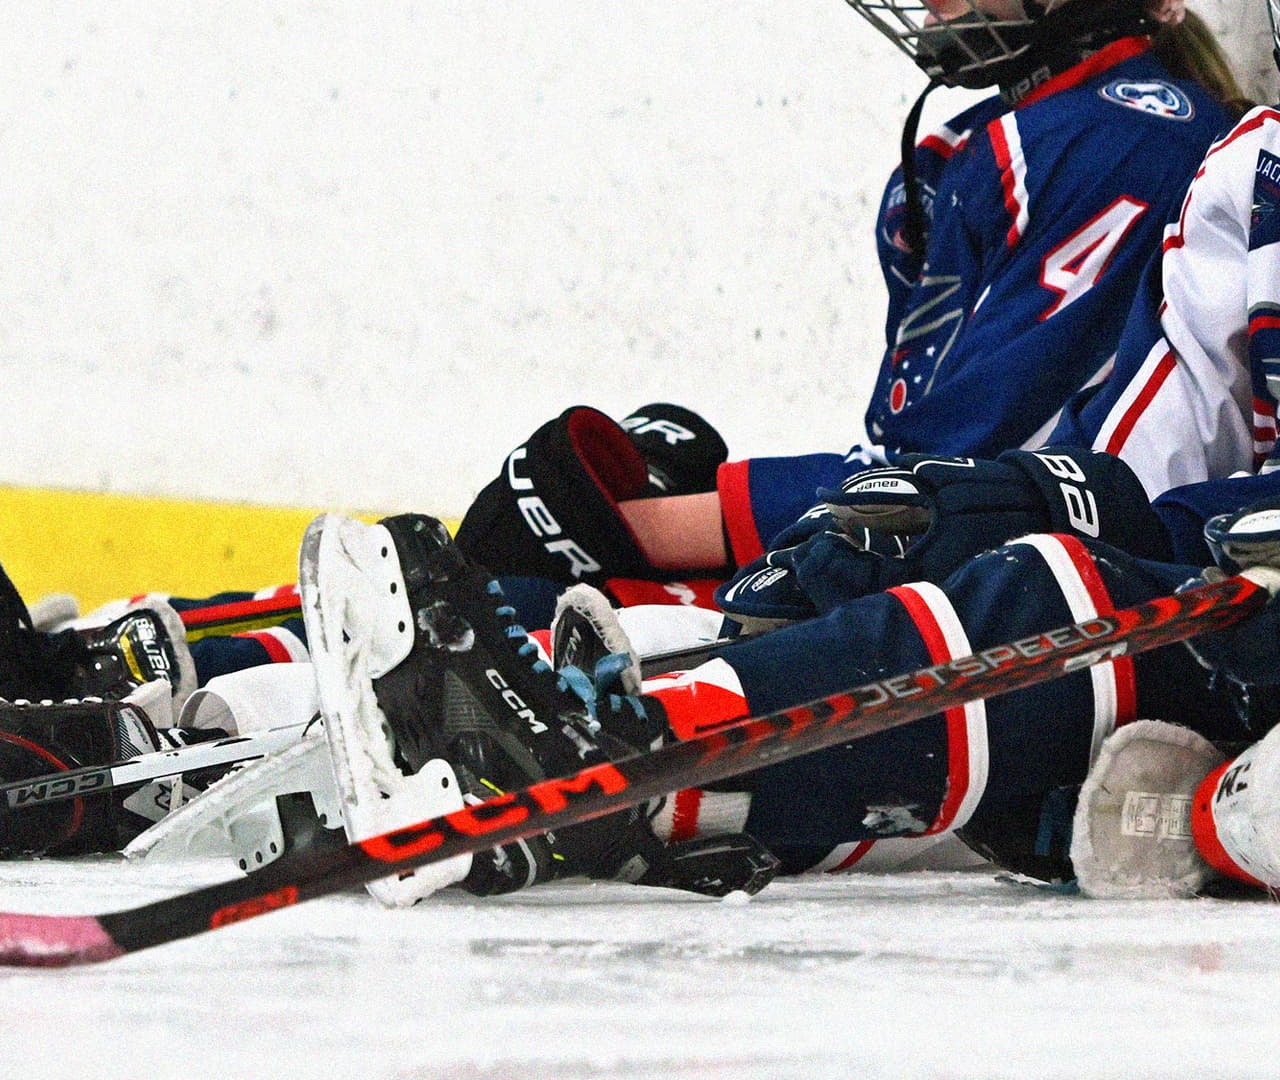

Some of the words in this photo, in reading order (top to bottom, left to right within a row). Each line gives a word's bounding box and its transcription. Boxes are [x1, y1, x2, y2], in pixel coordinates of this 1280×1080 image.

[1037, 194, 1151, 322] 4
[507, 447, 602, 578] UER
[485, 668, 549, 735] CCM
[860, 619, 1115, 708] JETSPEED
[16, 772, 106, 806] CCM
[360, 762, 629, 863] CCM
